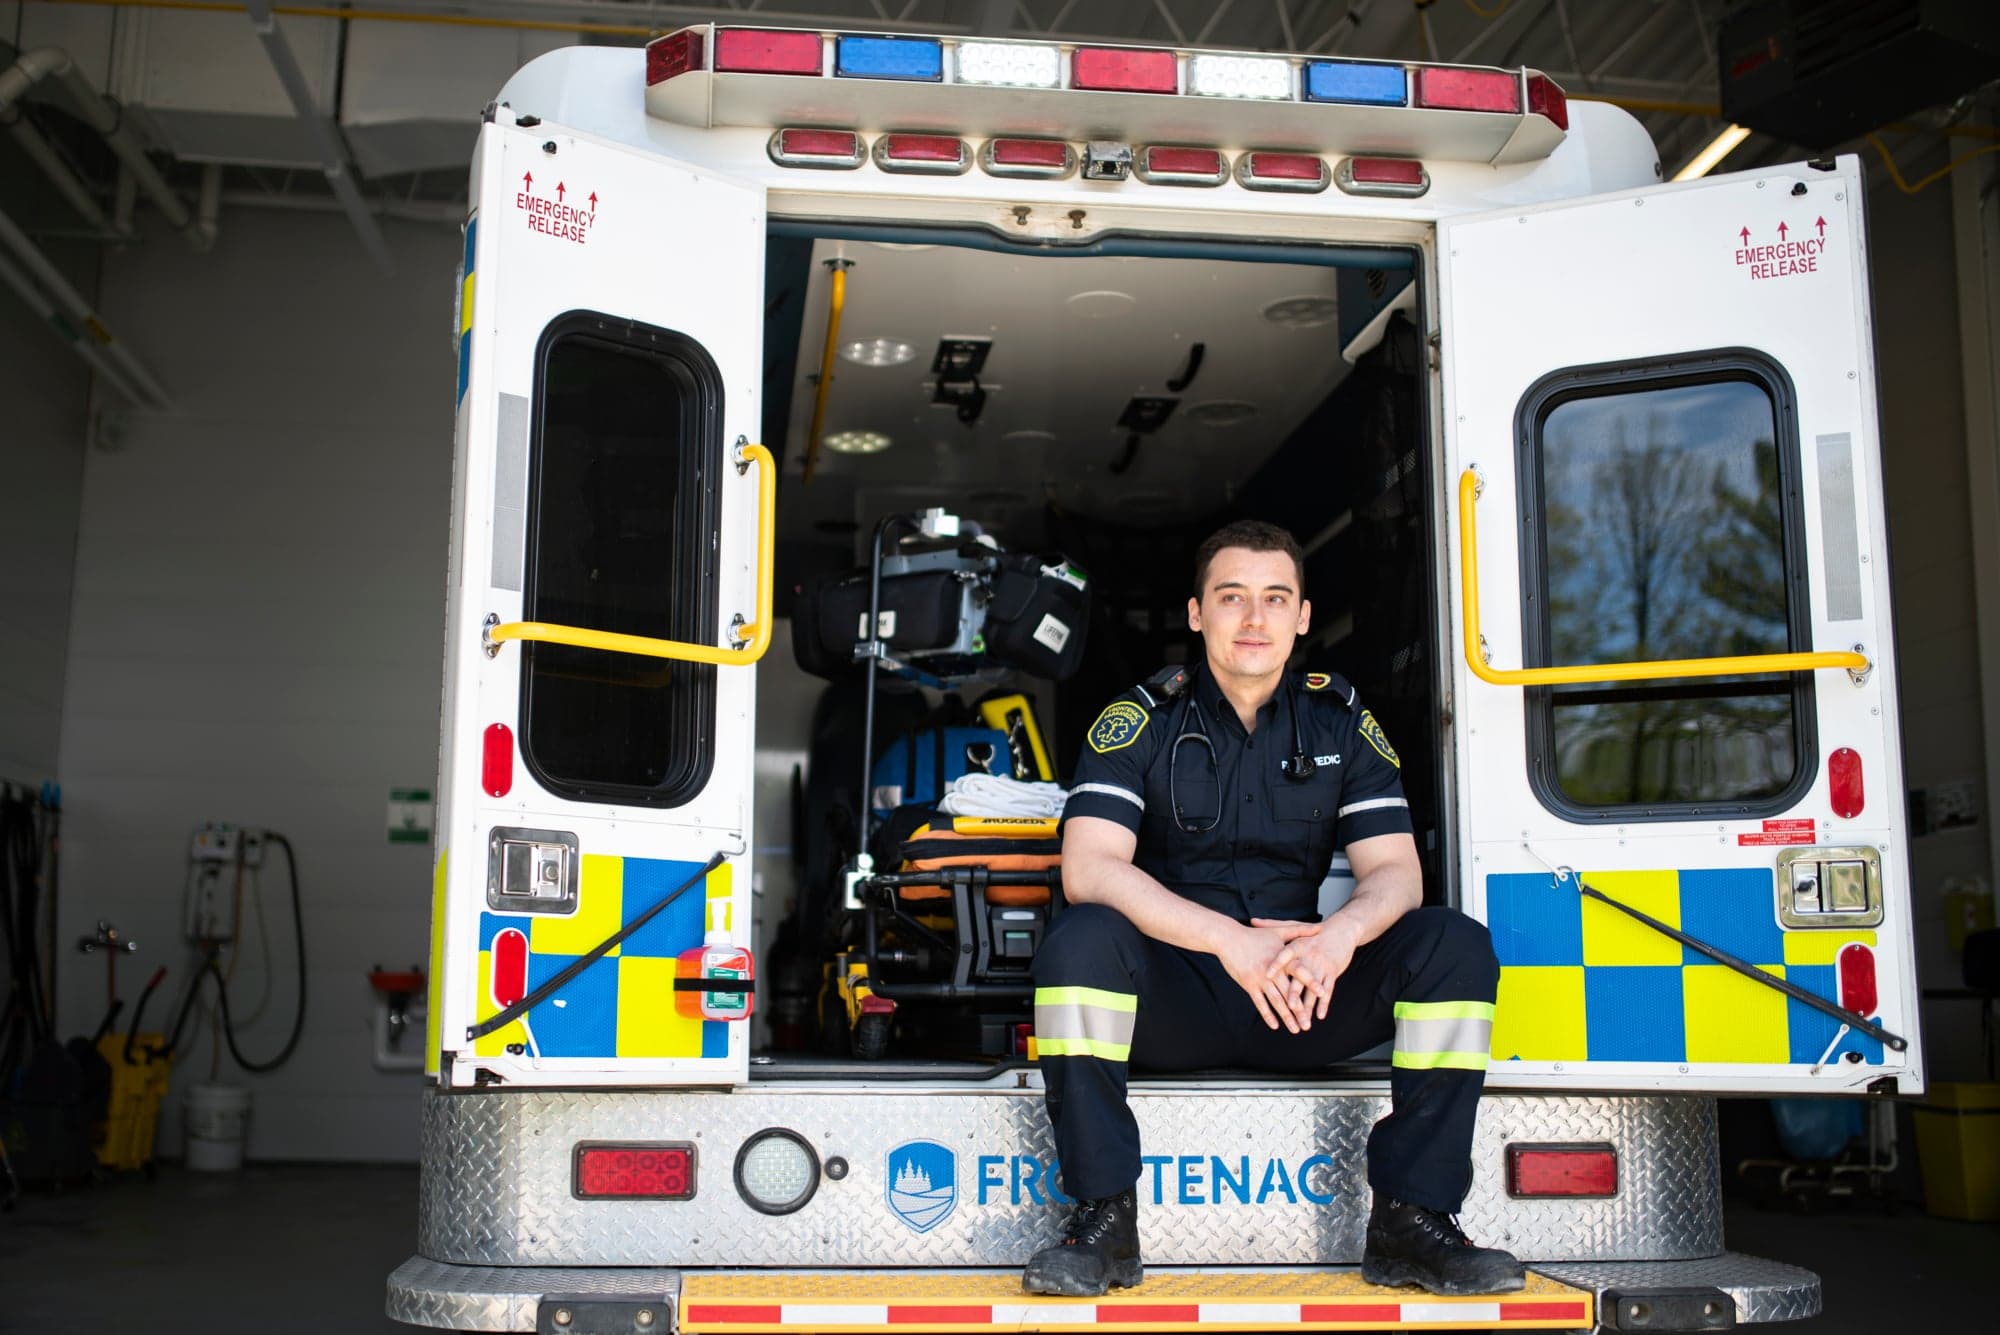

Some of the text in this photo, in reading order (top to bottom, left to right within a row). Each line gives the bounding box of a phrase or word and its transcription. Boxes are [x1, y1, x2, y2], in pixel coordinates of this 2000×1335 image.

[516, 192, 596, 228] EMERGENCY
[528, 214, 586, 244] RELEASE
[1735, 238, 1826, 265] EMERGENCY
[1751, 256, 1818, 280] RELEASE
[1281, 753, 1341, 770] PMEDIC
[977, 1155, 1336, 1206] FRTENAC
